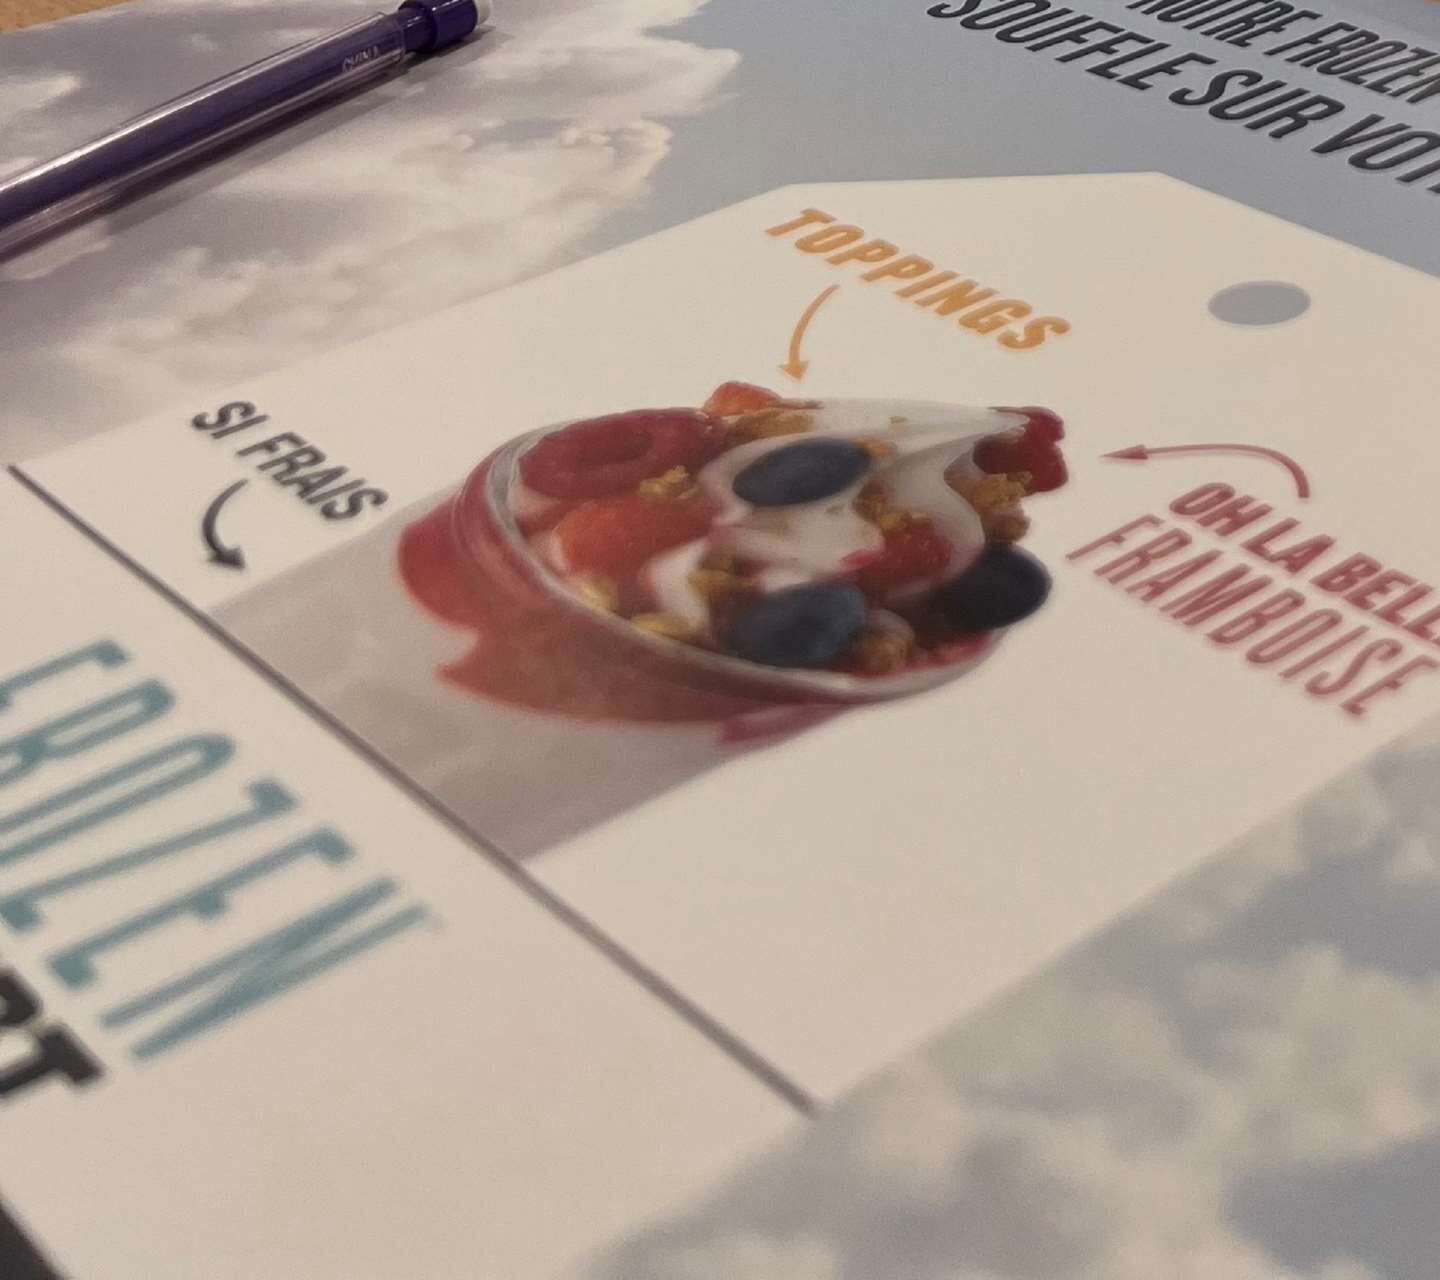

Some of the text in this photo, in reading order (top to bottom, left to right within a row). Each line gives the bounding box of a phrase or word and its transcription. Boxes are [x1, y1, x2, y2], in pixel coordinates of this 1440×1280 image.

[1169, 68, 1346, 139] SUR
[765, 207, 1072, 352] TOPPINGS
[191, 401, 390, 522] SI FRAIS
[1169, 482, 1273, 537] OH
[1242, 516, 1335, 574] LA
